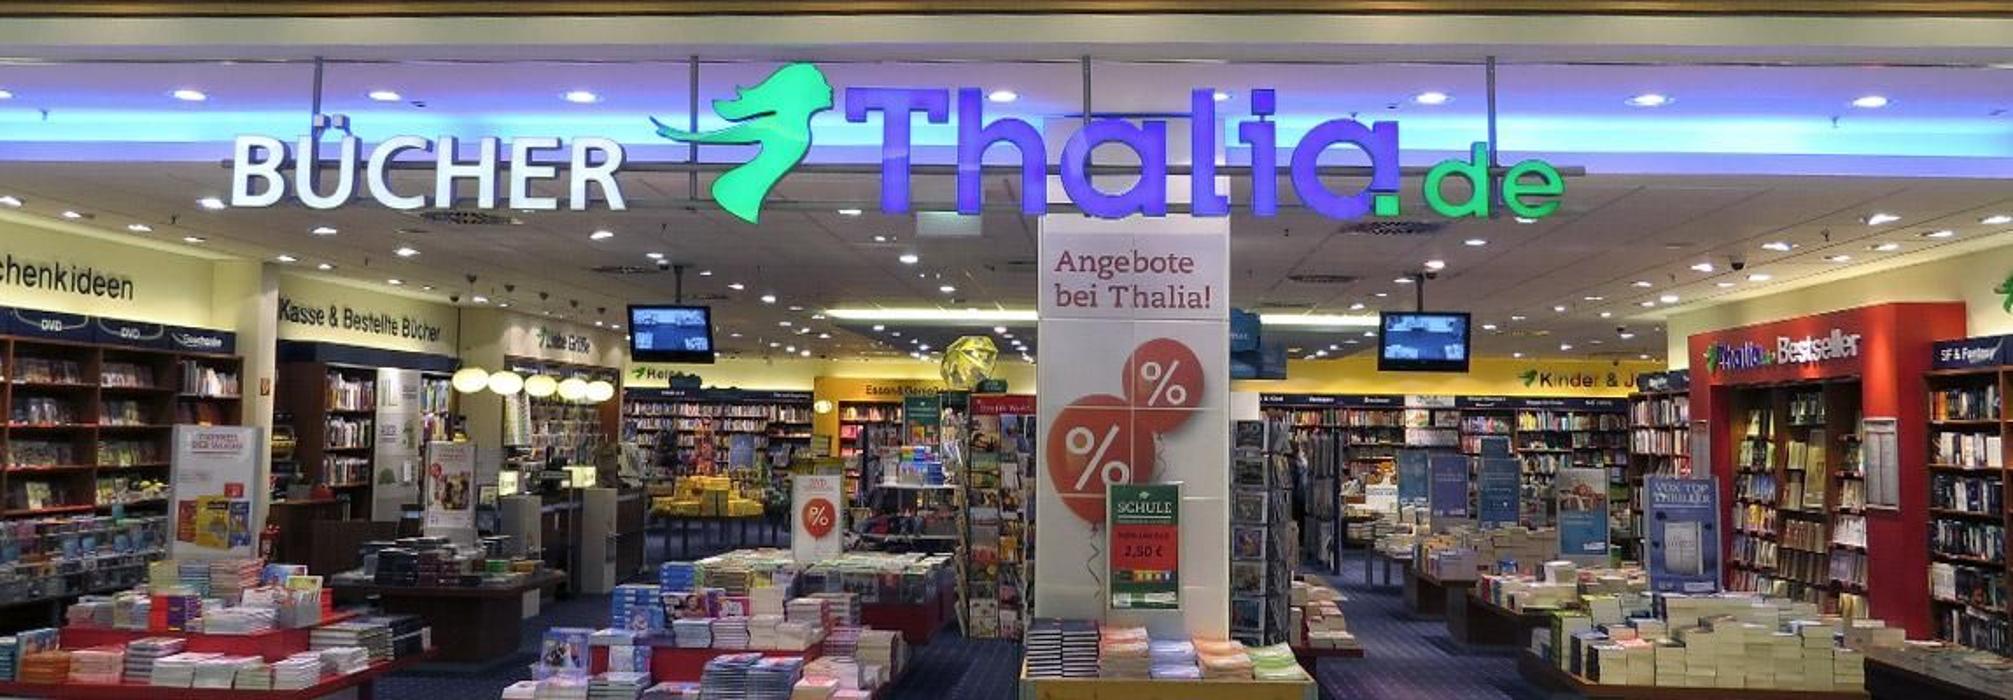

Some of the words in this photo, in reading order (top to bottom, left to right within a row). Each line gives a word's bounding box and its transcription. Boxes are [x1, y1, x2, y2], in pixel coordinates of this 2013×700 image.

[231, 112, 629, 211] BÜCHER
[1054, 249, 1194, 280] Angebote
[1054, 283, 1098, 308] bei
[1108, 284, 1211, 309] Thalia!
[41, 318, 62, 332] DVD
[278, 299, 325, 327] Kasse
[328, 304, 339, 329] &
[343, 306, 399, 337] Bestellte
[402, 316, 442, 343] Bücher
[120, 326, 141, 340] DVD
[1777, 328, 1861, 365] Bestseller
[1941, 348, 1953, 361] SF
[1953, 347, 1961, 360] &
[1540, 371, 1599, 388] Kinder
[1606, 372, 1618, 388] &
[1685, 483, 1710, 494] TOP
[1117, 501, 1173, 515] SCHULE
